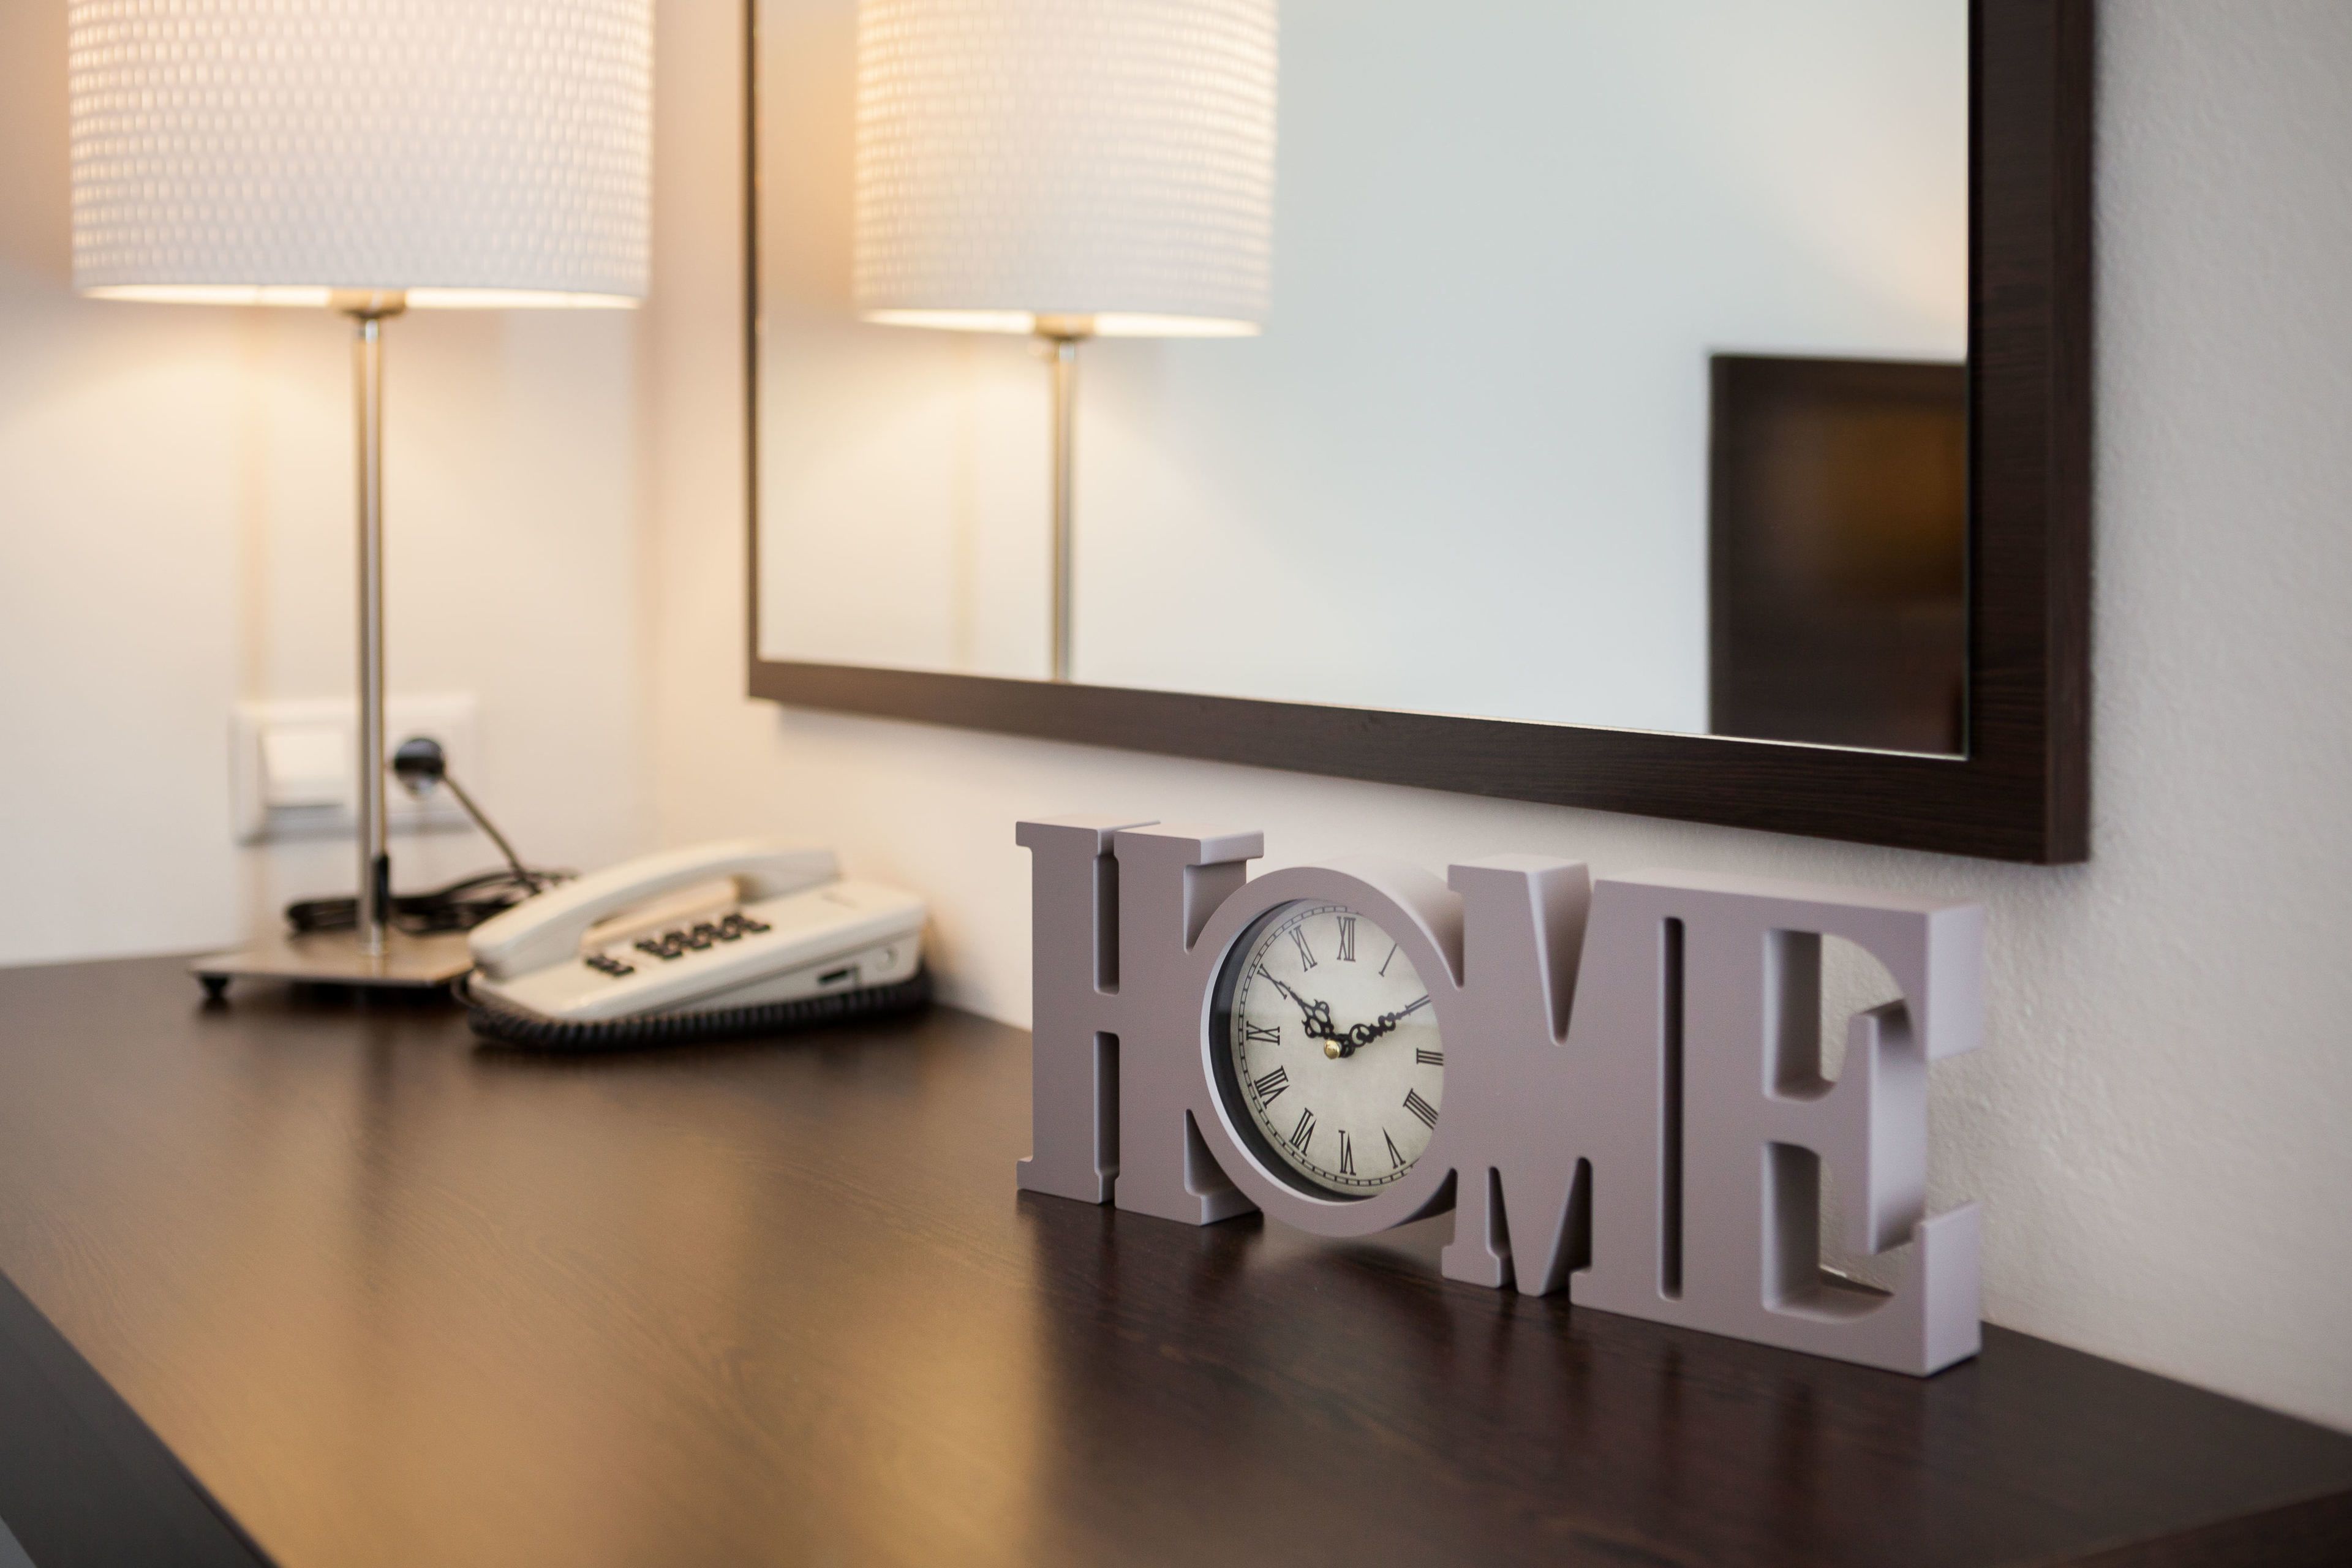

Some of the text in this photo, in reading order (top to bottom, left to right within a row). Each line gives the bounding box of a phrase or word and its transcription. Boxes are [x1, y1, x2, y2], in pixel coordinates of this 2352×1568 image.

[1289, 925, 1317, 972] XI
[1336, 916, 1356, 962] XII
[1257, 963, 1287, 1000] X
[1246, 1020, 1280, 1046] IX
[1017, 821, 1983, 1376] HOME
[1254, 1065, 1291, 1110] VIII
[1289, 1107, 1317, 1157] VII
[1338, 1129, 1356, 1176] VI
[1382, 1126, 1406, 1169] V
